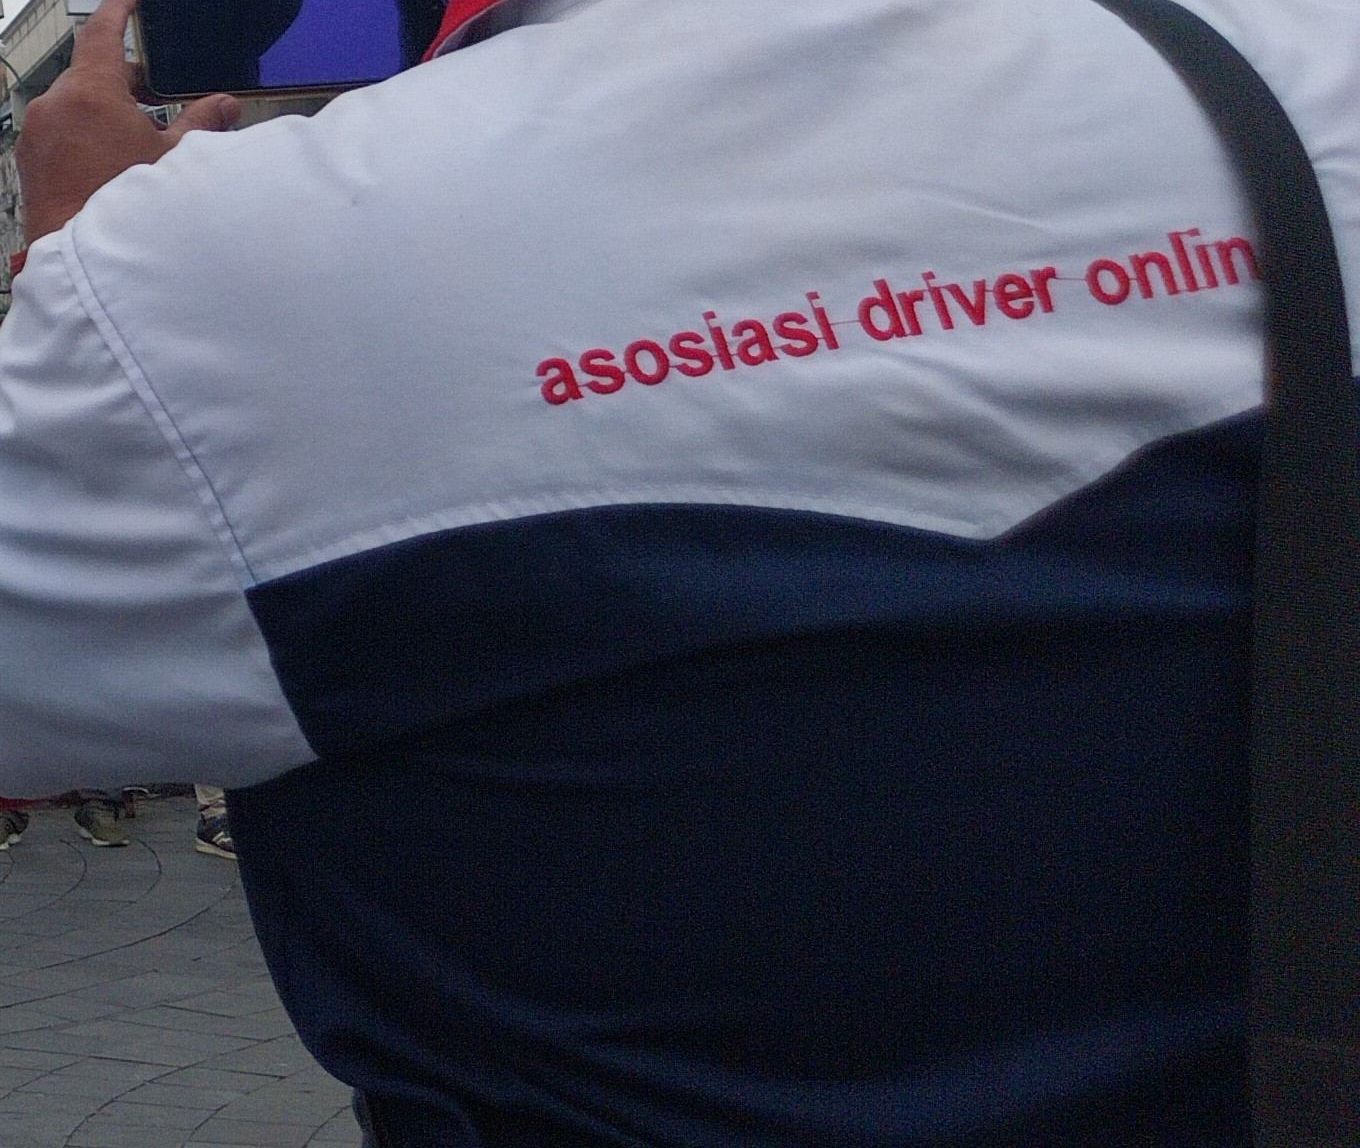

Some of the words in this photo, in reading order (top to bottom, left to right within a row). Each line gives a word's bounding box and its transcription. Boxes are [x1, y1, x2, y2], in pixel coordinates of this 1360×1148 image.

[535, 292, 841, 406] asosiasi
[856, 264, 1056, 341] driver
[1086, 228, 1262, 305] onlin
